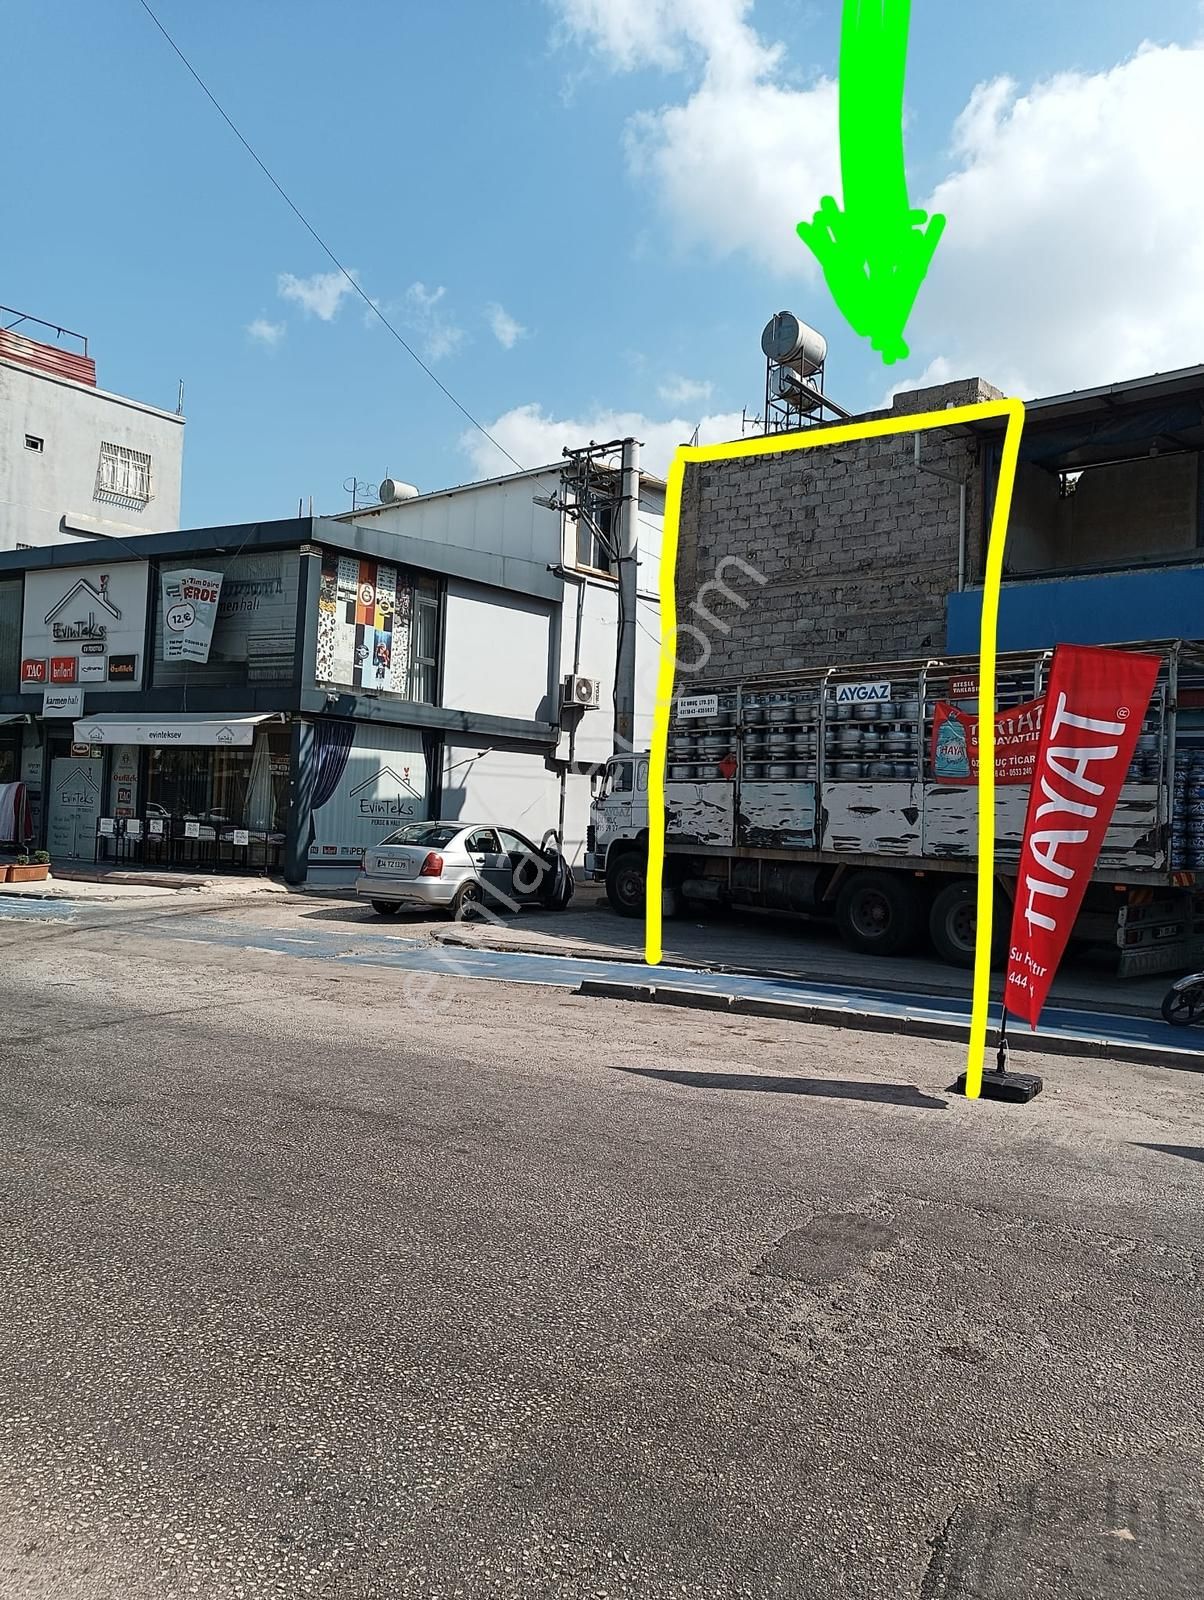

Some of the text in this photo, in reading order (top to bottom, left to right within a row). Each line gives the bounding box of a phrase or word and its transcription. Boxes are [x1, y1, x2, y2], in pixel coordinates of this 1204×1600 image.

[838, 685, 889, 701] AYGAZ
[359, 793, 414, 816] EvinTeks
[1024, 692, 1126, 938] HAYAT
[1009, 947, 1022, 962] Su
[1008, 971, 1028, 988] 444
